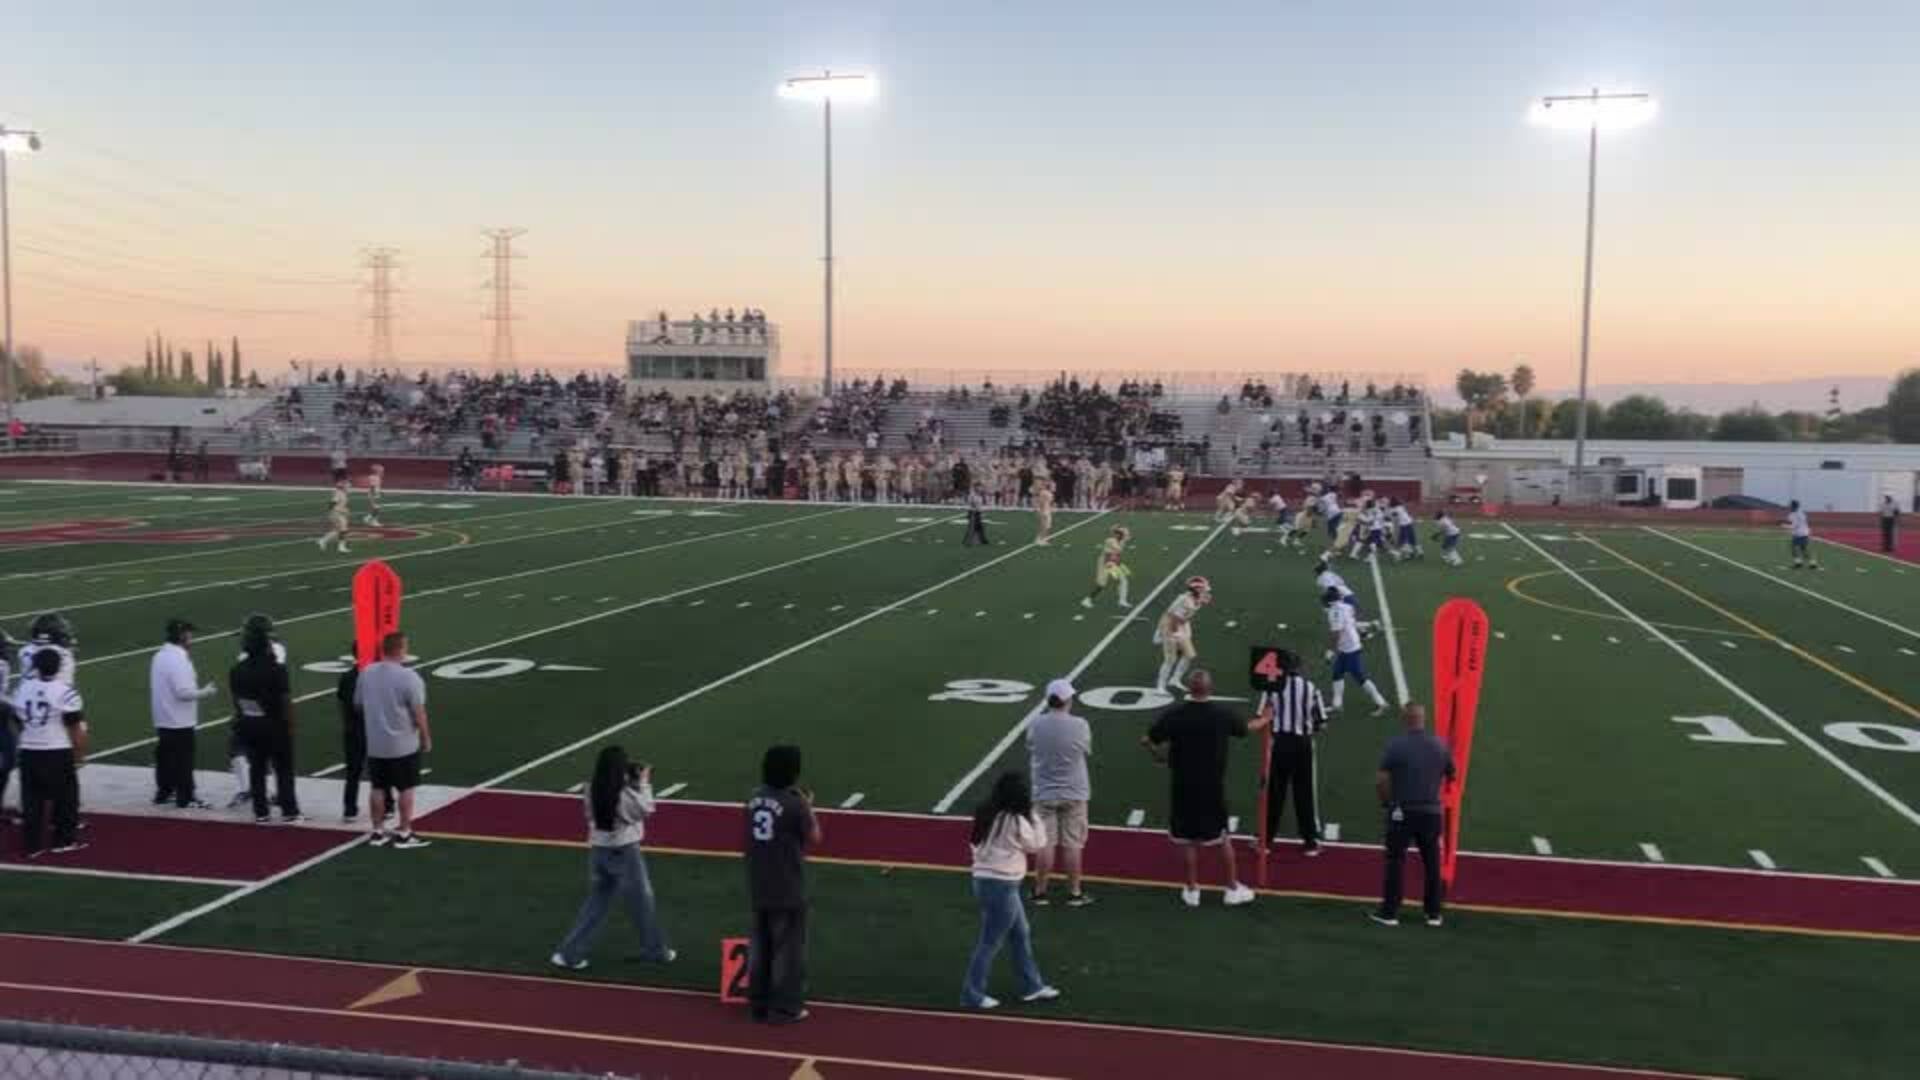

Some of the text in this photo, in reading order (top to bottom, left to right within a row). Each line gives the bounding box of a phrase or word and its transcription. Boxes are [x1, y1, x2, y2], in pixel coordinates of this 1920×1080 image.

[1253, 650, 1282, 681] 4
[1669, 715, 1920, 752] 10
[753, 810, 774, 840] 3
